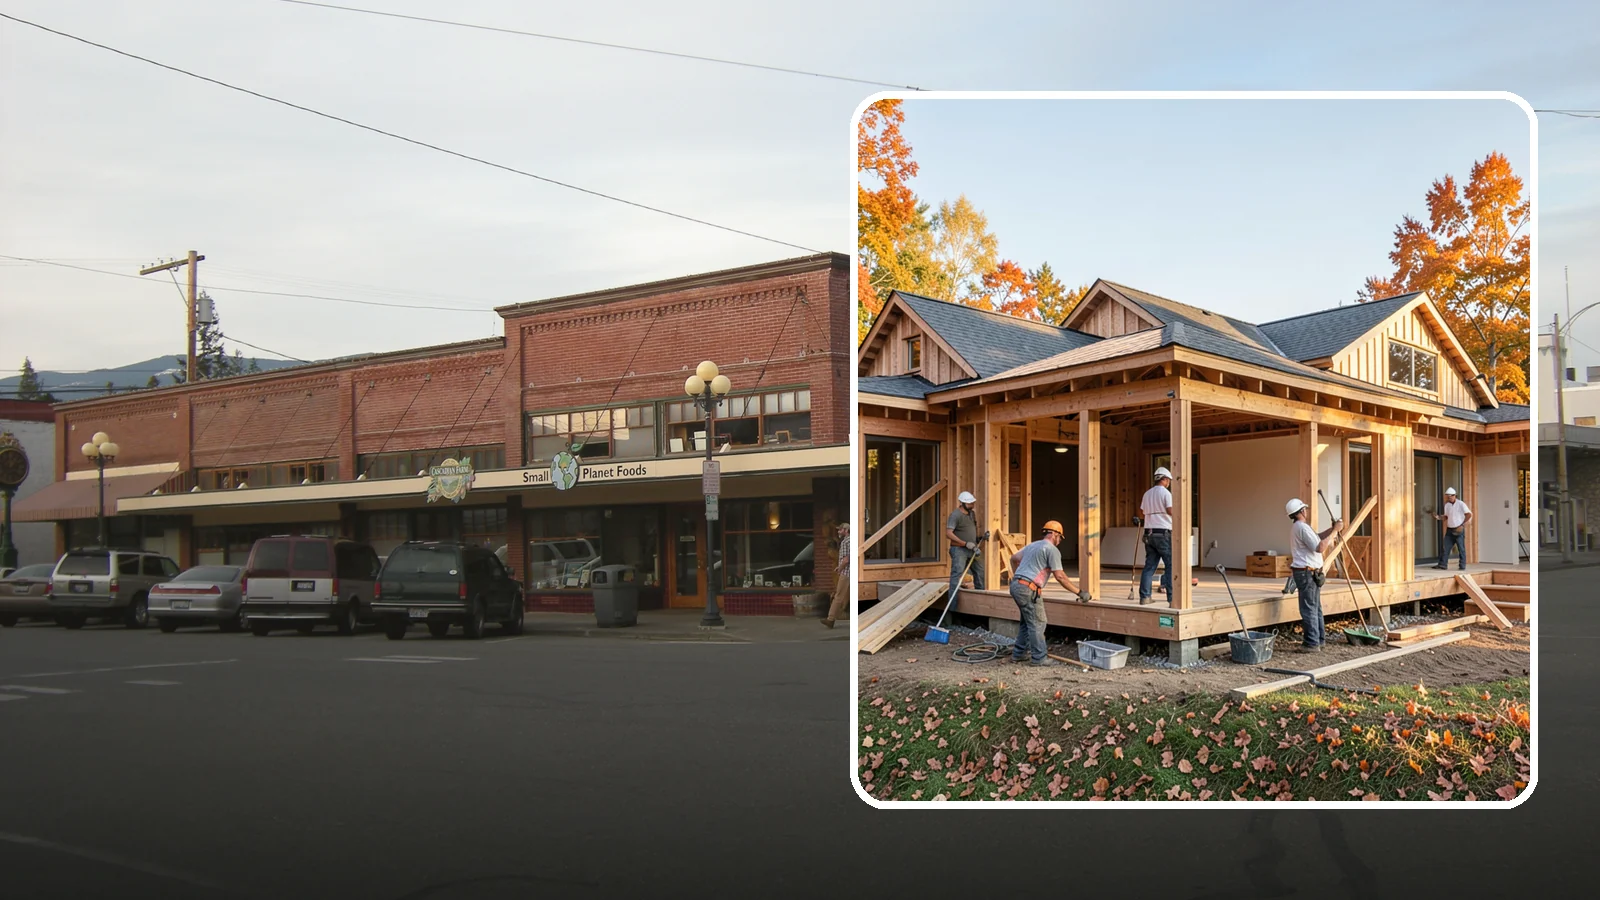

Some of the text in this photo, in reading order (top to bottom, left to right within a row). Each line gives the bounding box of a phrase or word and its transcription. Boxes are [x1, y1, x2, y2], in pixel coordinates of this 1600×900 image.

[523, 464, 647, 483] Small Planet Foods
